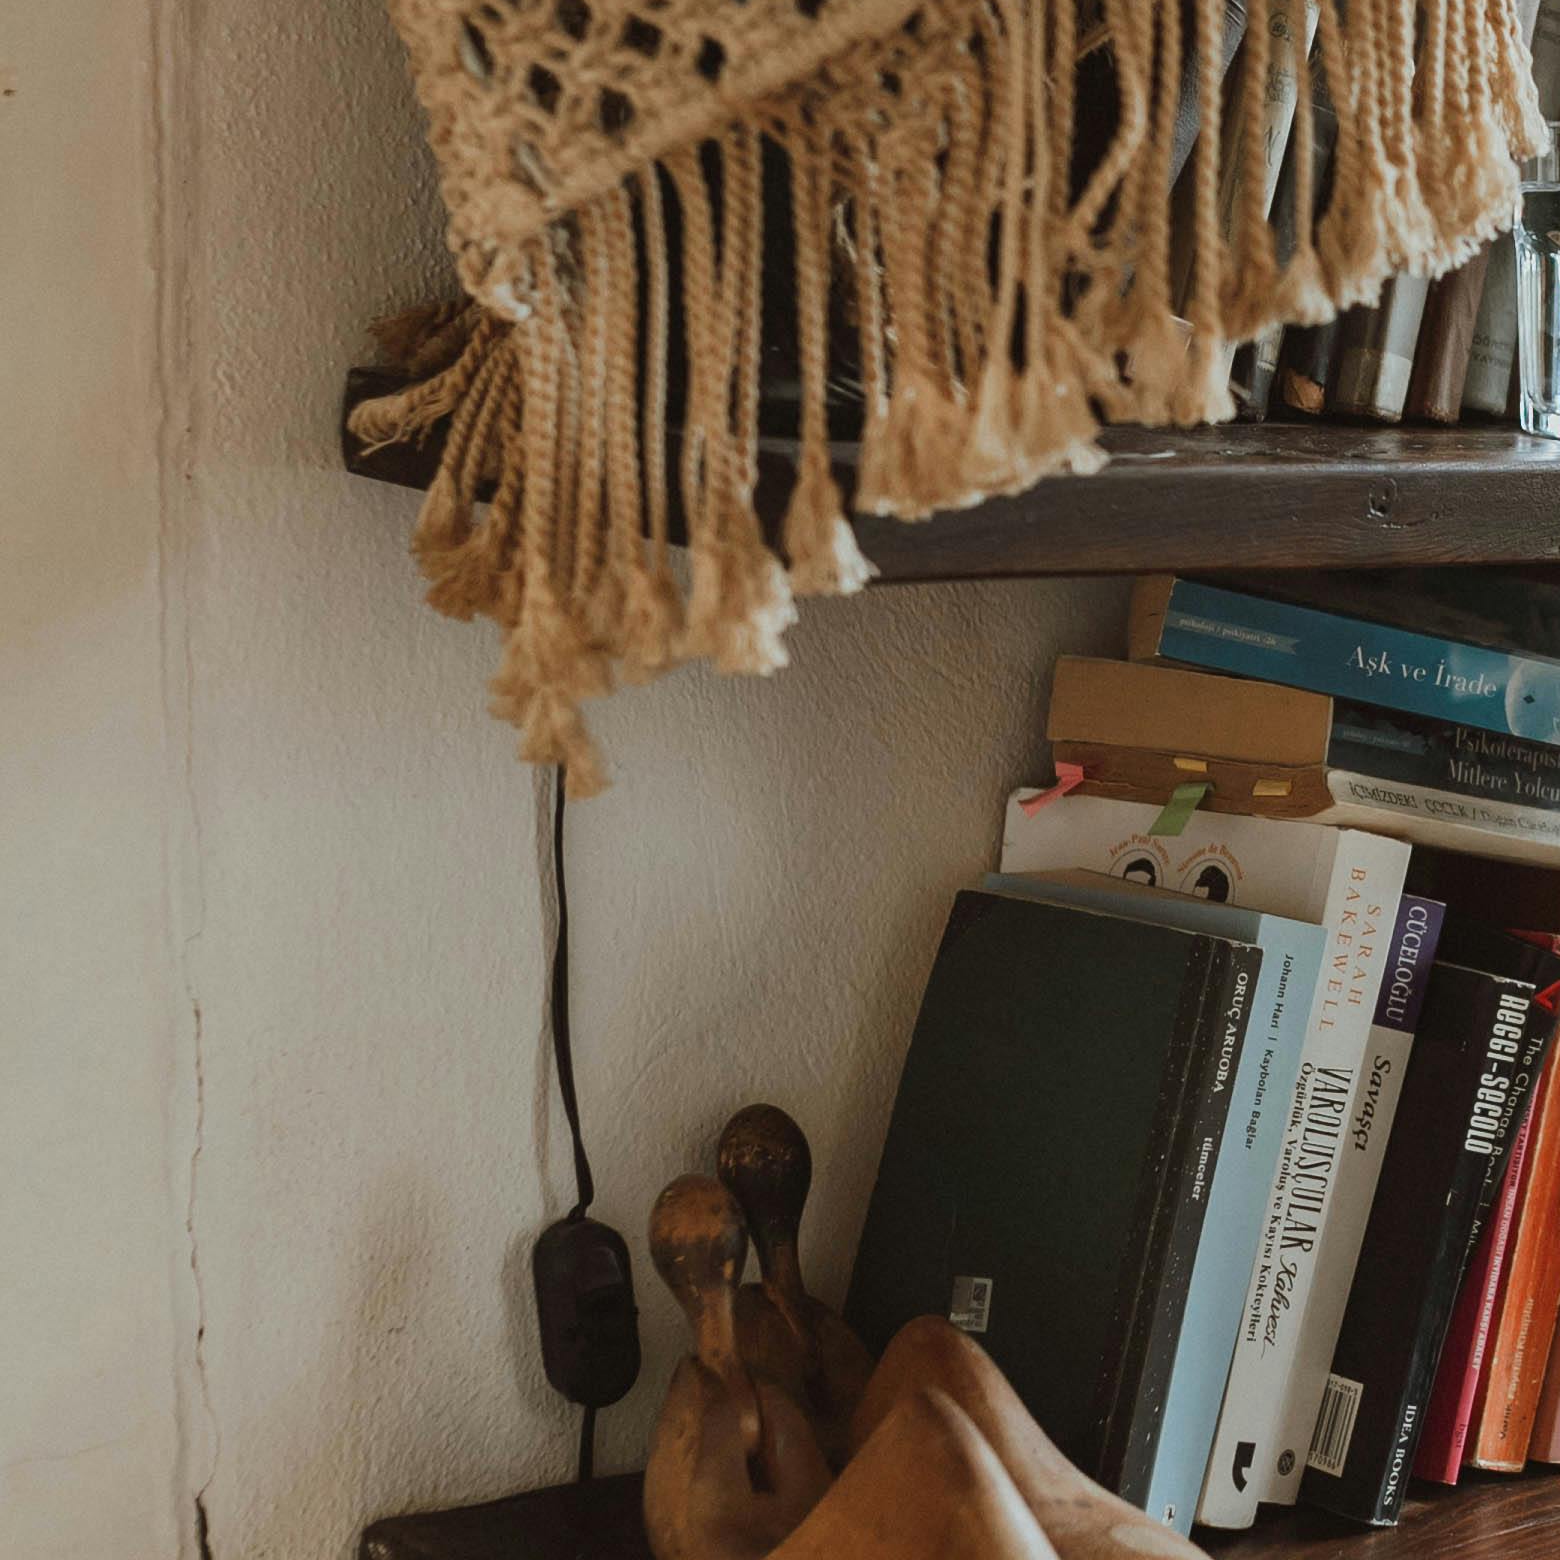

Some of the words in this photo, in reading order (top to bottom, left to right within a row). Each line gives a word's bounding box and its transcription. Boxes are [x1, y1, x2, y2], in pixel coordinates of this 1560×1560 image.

[1346, 646, 1391, 677] Aşk
[1402, 663, 1427, 682] ve
[1434, 659, 1497, 698] İrade
[1447, 759, 1508, 792] Mitlere
[1423, 799, 1466, 817] ÇOCUK
[1275, 953, 1295, 998] Johann
[1316, 866, 1367, 1034] BAKEWELL
[1345, 903, 1383, 1007] SARAH
[1383, 903, 1431, 1024] CÜCELOĞLU
[1223, 970, 1248, 1019] ORUÇ
[1269, 1001, 1284, 1028] Hari
[1210, 1022, 1237, 1094] ARUOBA
[1250, 1047, 1274, 1106] Kaybolan
[1520, 1034, 1543, 1066] The
[1286, 1060, 1314, 1134] Özgürlük,
[1346, 1053, 1393, 1154] Savaşçı
[1241, 1109, 1262, 1151] Bağlar
[1190, 1135, 1215, 1201] tümceler
[1273, 1138, 1298, 1192] Varoluş
[1276, 1062, 1353, 1255] VAROLUŞÇULAR
[1271, 1194, 1284, 1210] ve
[1260, 1214, 1282, 1259] Kayısı
[1242, 1263, 1272, 1344] Kokteylleri
[1257, 1253, 1296, 1361] Kahvesi
[1398, 1402, 1417, 1443] IDEA
[1382, 1447, 1407, 1507] BOOKS
